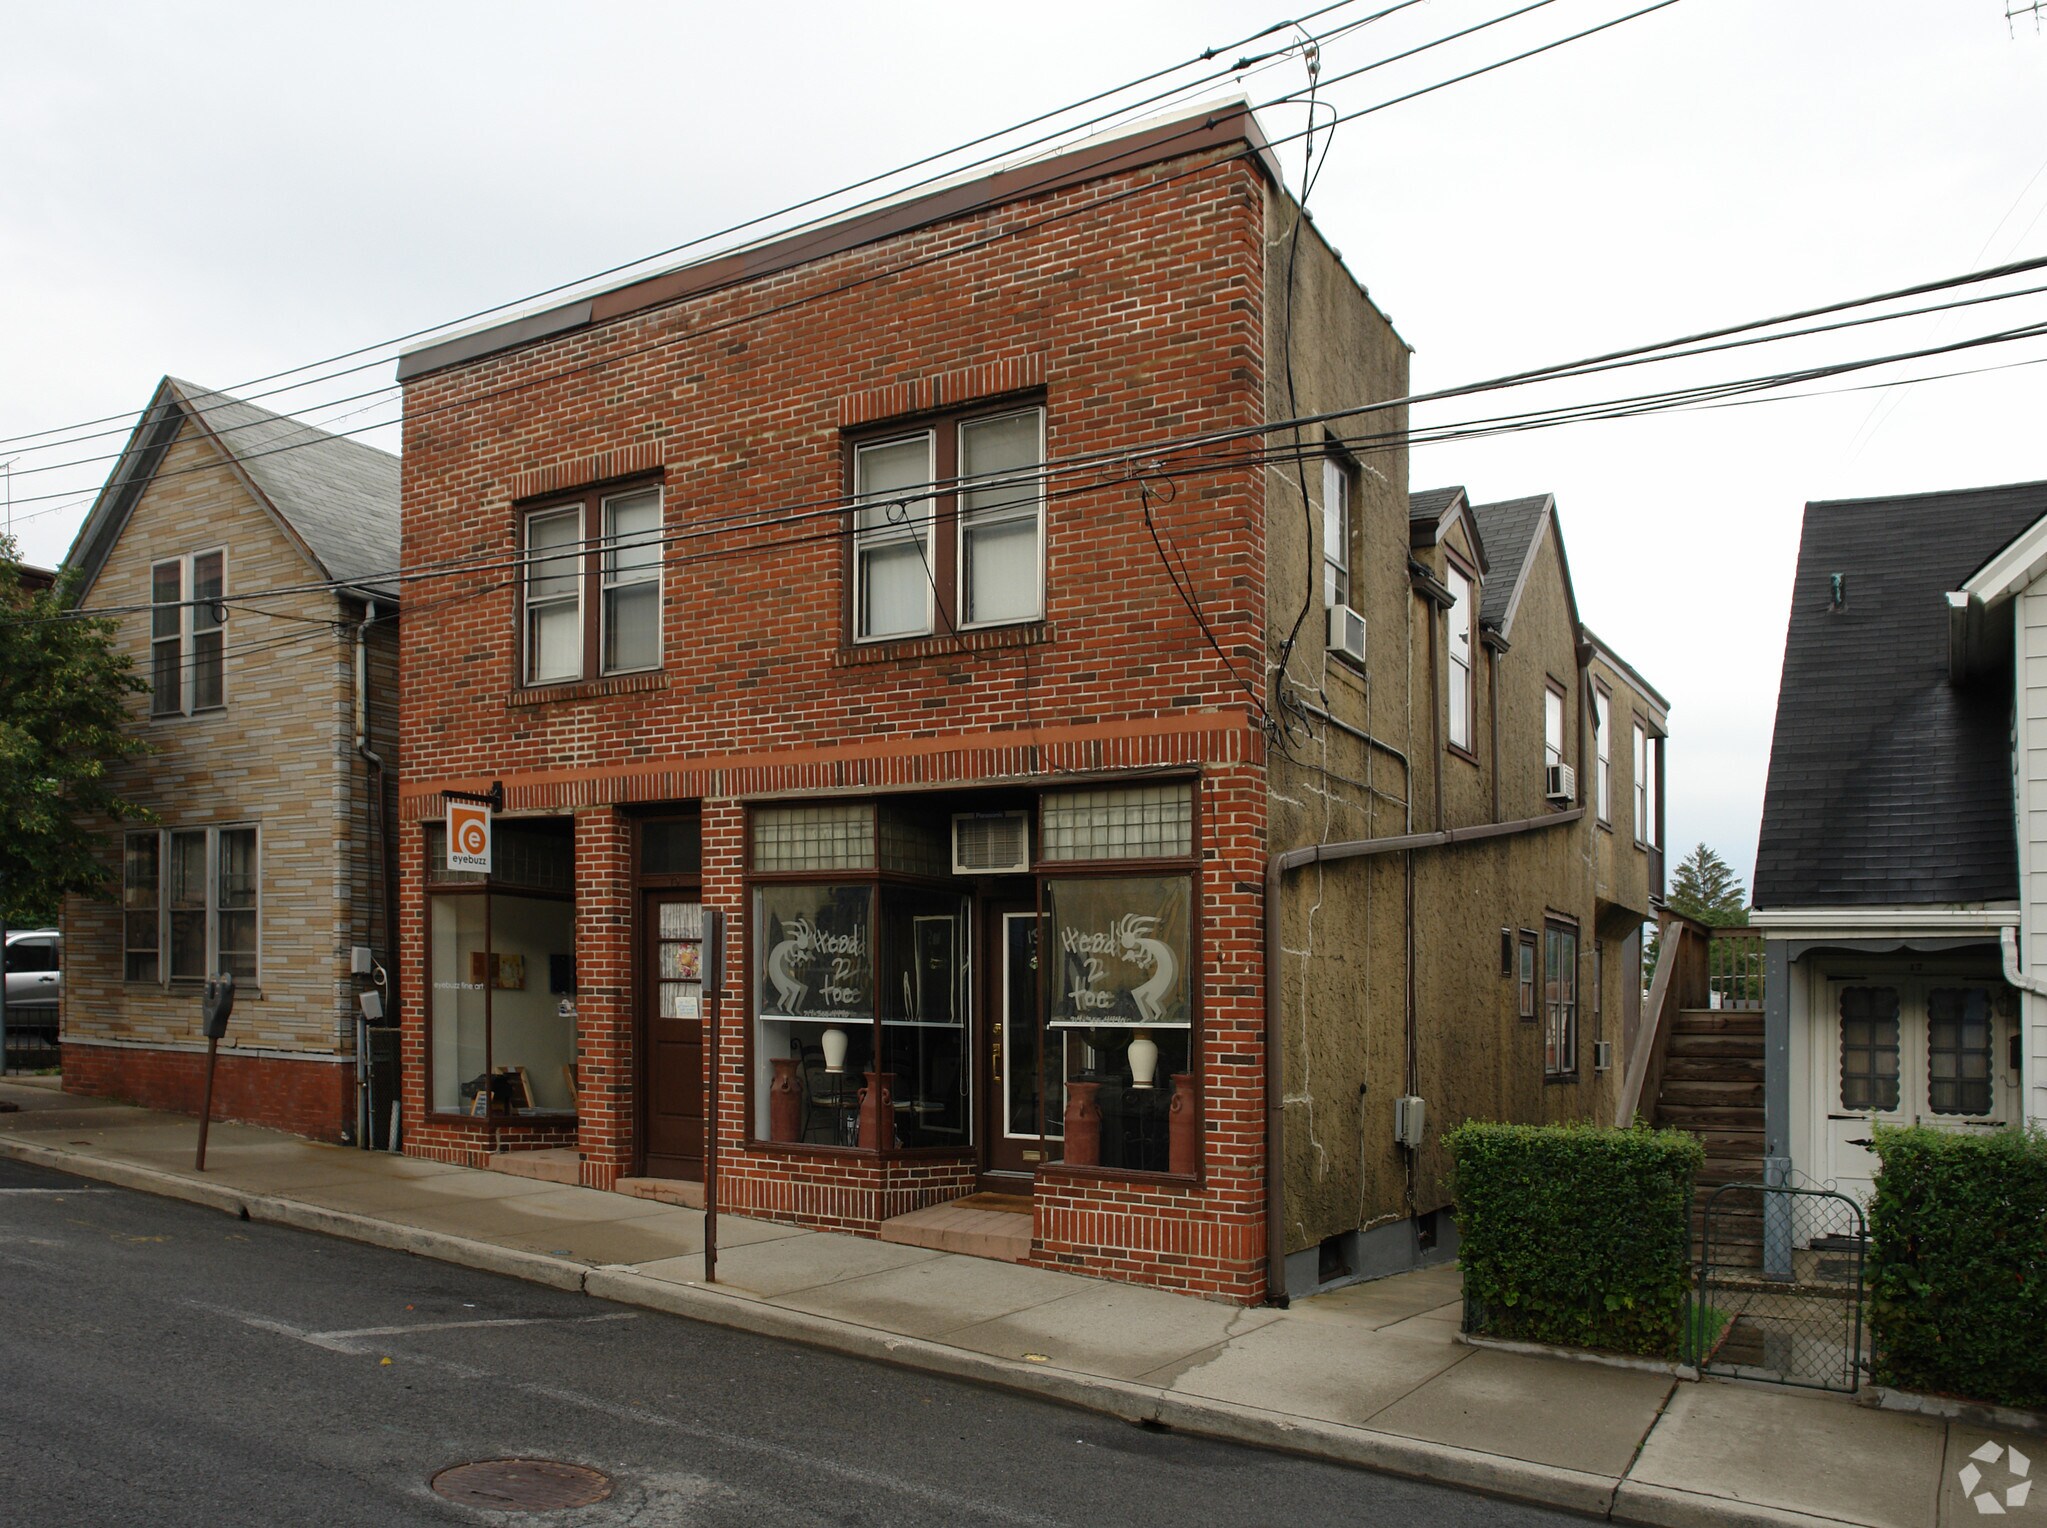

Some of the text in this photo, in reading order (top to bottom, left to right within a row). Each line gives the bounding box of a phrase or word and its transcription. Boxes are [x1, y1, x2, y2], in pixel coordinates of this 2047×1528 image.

[452, 854, 486, 866] eyebuzz
[814, 923, 860, 957] Head
[1061, 920, 1117, 957] Head
[831, 957, 853, 981] 2
[1083, 957, 1105, 982] 2
[433, 981, 460, 990] eyebuzz
[461, 981, 474, 990] fine
[819, 974, 856, 1006] toe
[1068, 975, 1111, 1011] toe
